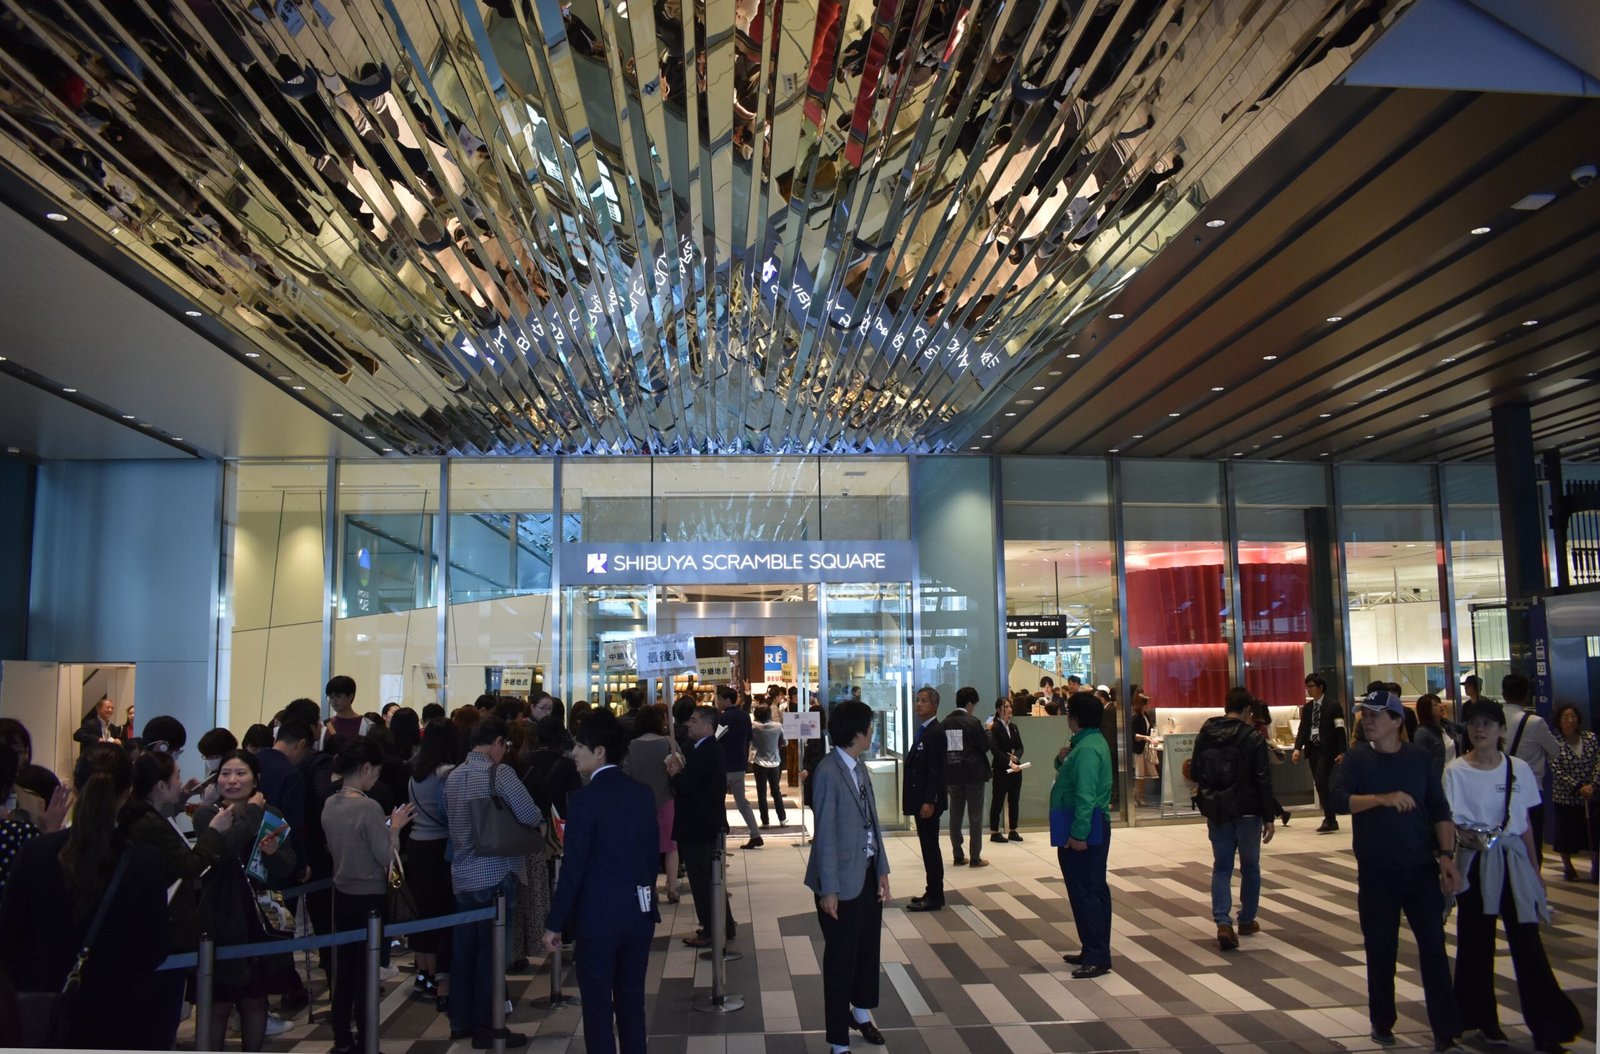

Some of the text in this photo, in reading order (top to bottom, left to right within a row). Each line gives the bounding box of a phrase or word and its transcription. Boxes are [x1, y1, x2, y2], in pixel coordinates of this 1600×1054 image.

[613, 553, 886, 571] SHIBUYA SCRAMBLE SQUARE
[647, 649, 684, 663] 最後尾
[700, 667, 727, 675] 中継地点
